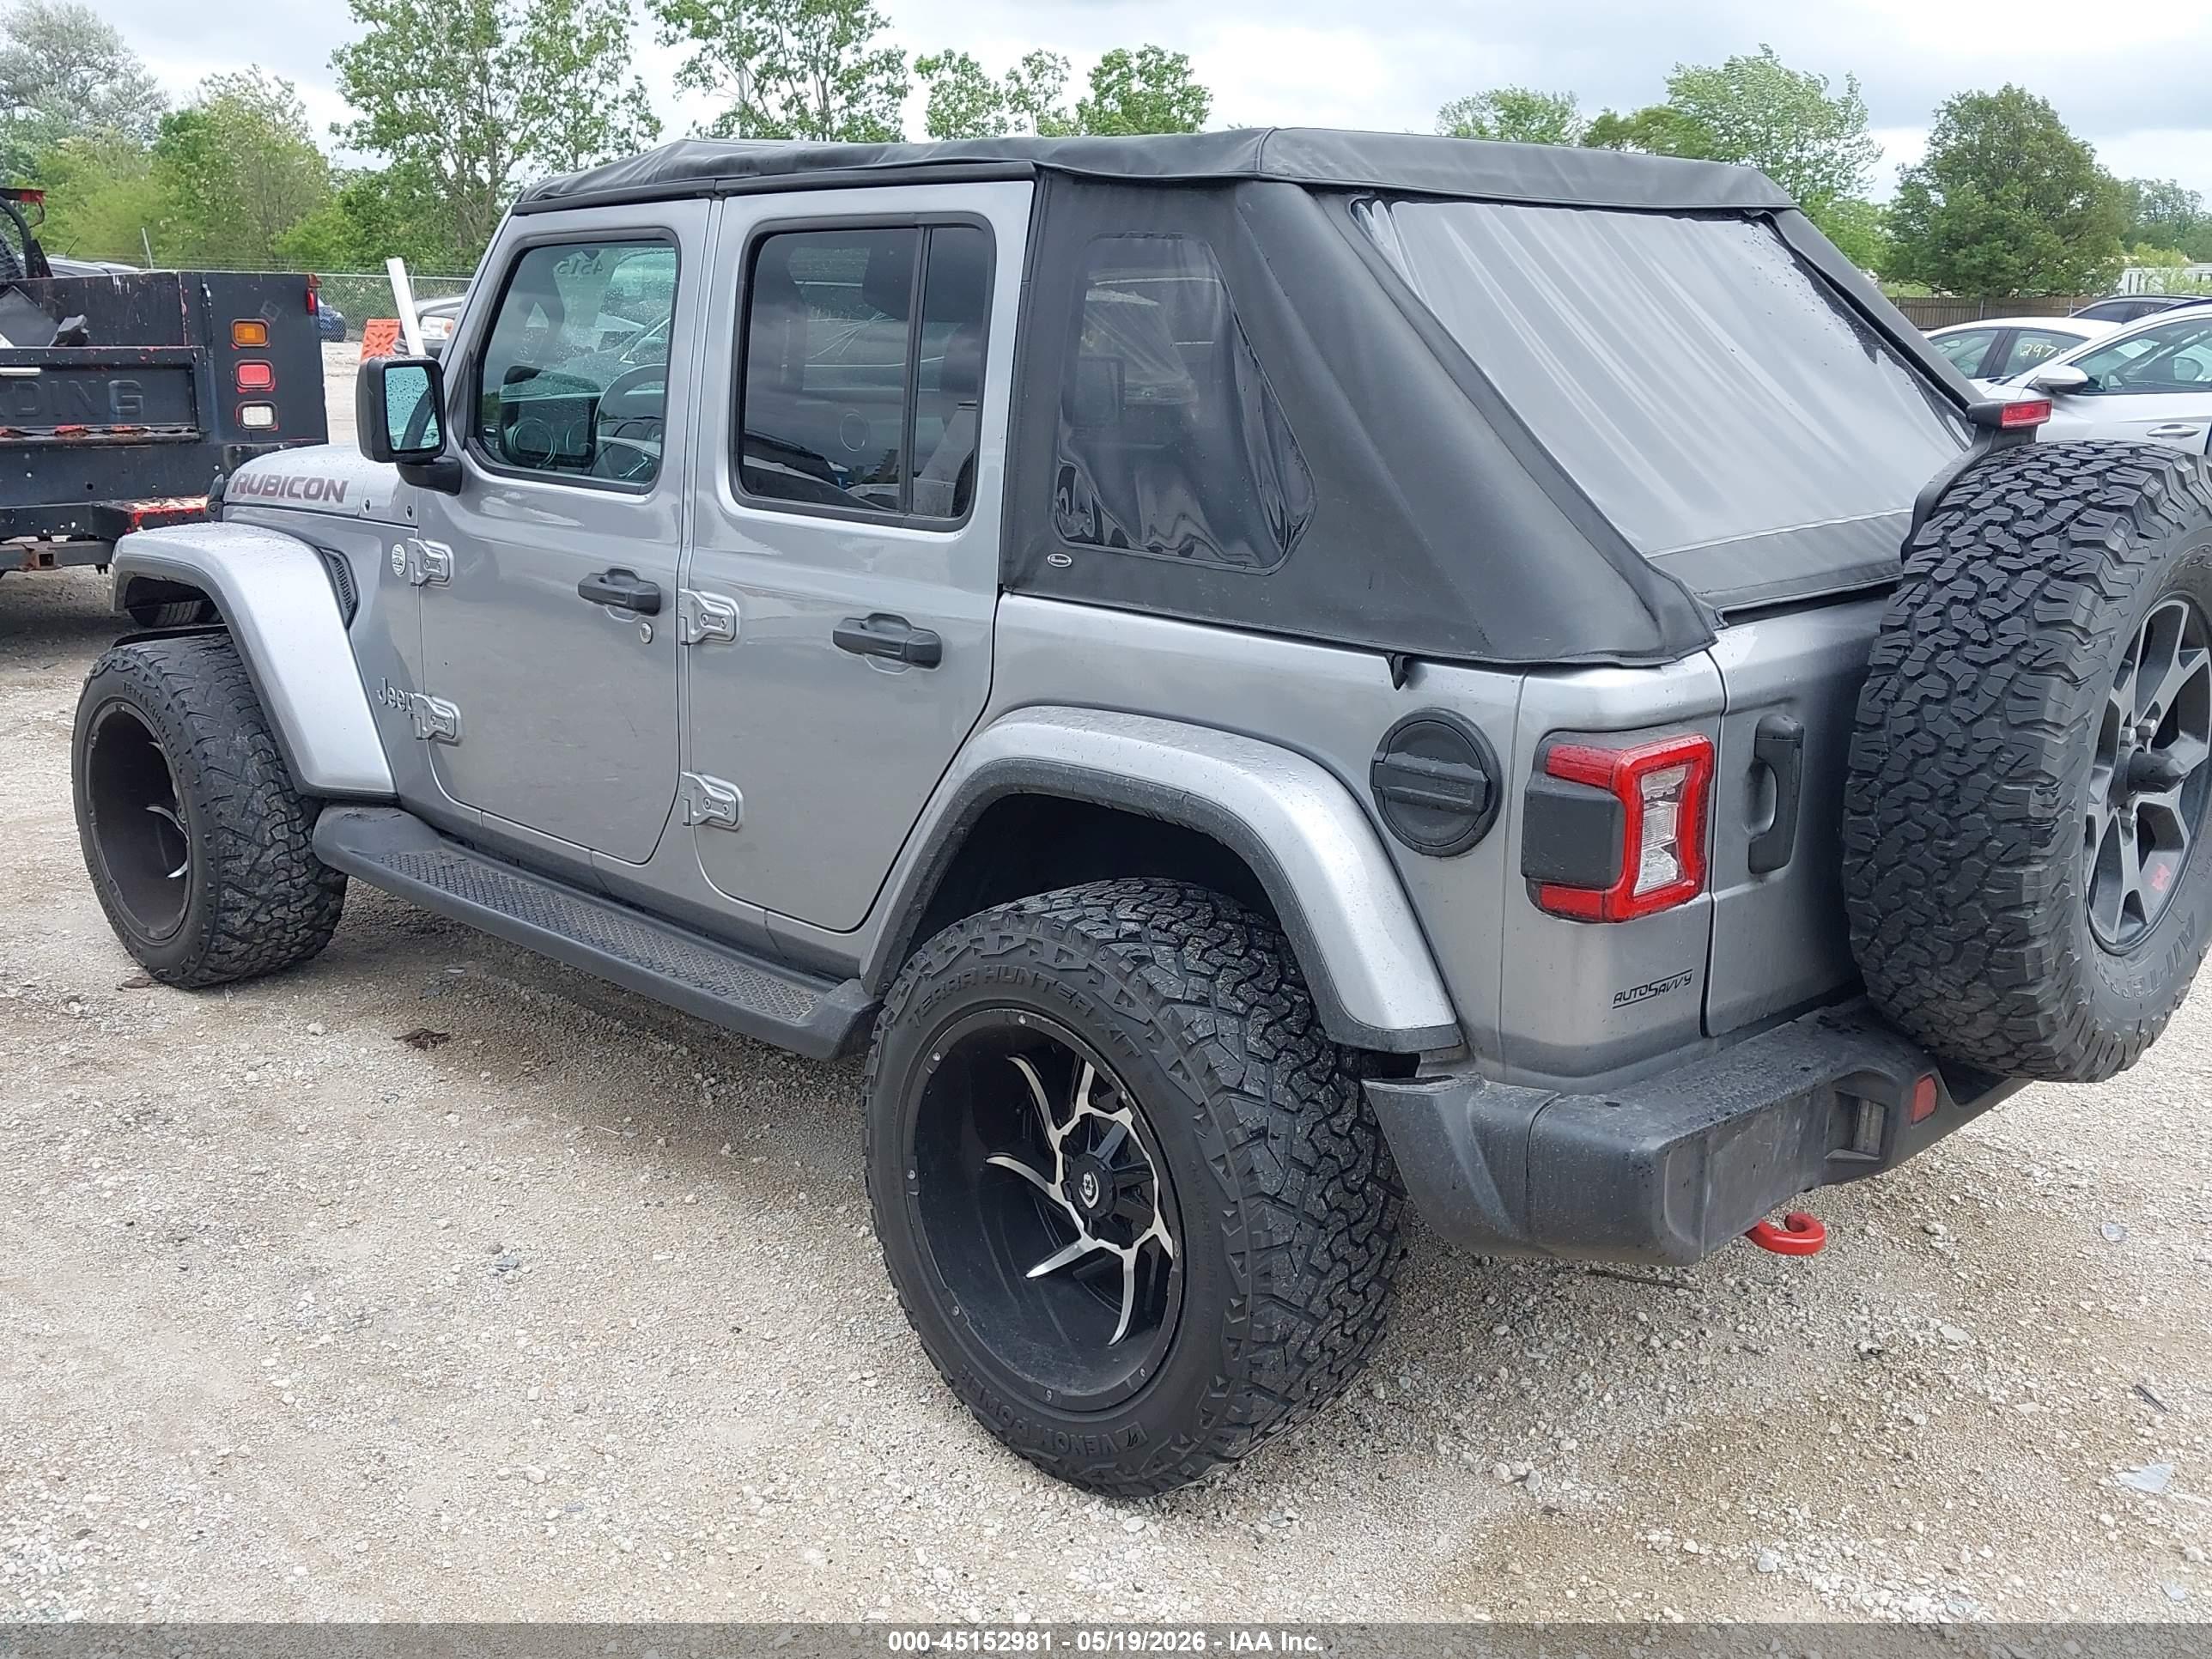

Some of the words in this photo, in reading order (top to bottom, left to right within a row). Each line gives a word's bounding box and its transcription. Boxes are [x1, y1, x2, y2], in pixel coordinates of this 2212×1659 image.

[0, 380, 143, 418] DING
[231, 473, 349, 503] RUBICON
[908, 967, 977, 1029] TERRA
[983, 963, 1095, 1017] HUNTER
